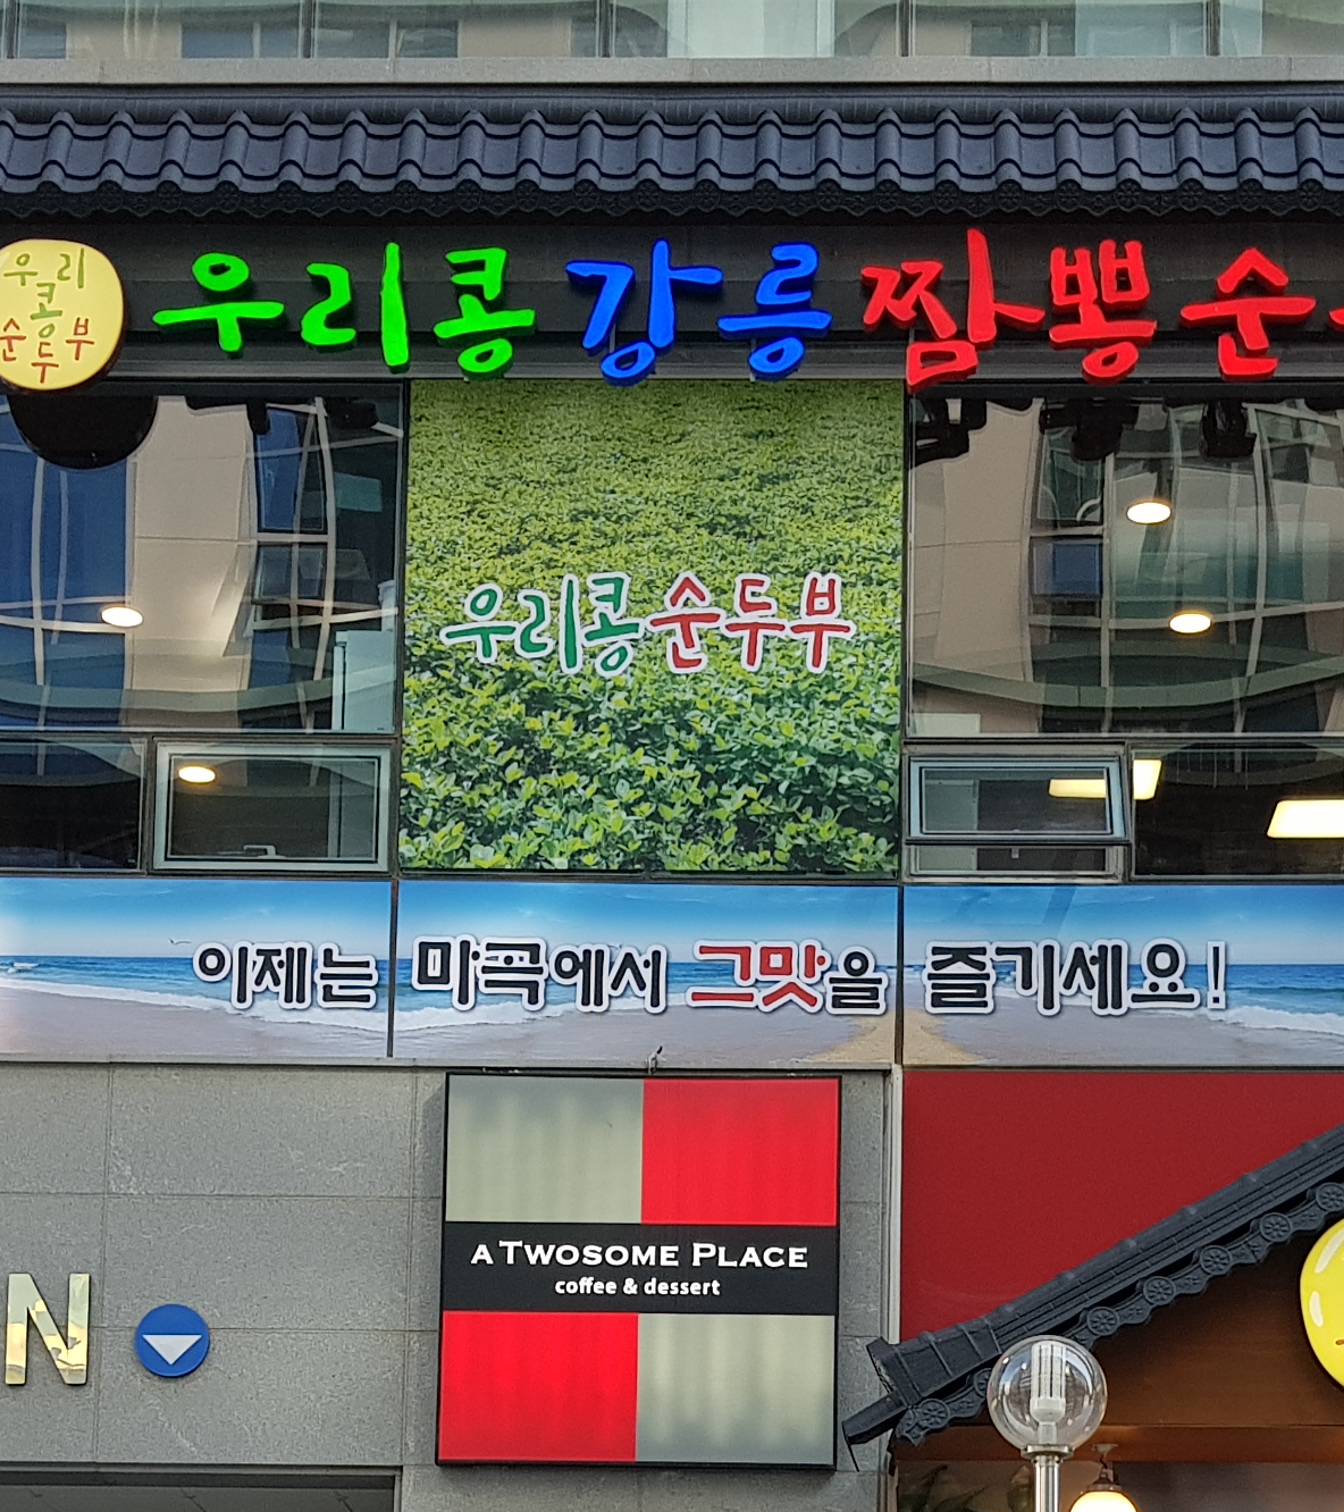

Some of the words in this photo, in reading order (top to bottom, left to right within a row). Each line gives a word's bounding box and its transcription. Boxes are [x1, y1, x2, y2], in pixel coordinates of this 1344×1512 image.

[152, 242, 536, 376] 우리콩
[564, 237, 833, 387] 강릉
[195, 943, 376, 1007] 이제는
[416, 936, 664, 1011] 마곡에서
[927, 942, 1227, 1014] 즐기세요!
[470, 1243, 494, 1265] A
[692, 1242, 809, 1269] PLACE
[555, 1276, 617, 1296] coffee
[622, 1278, 638, 1295] &
[644, 1277, 721, 1296] dessert
